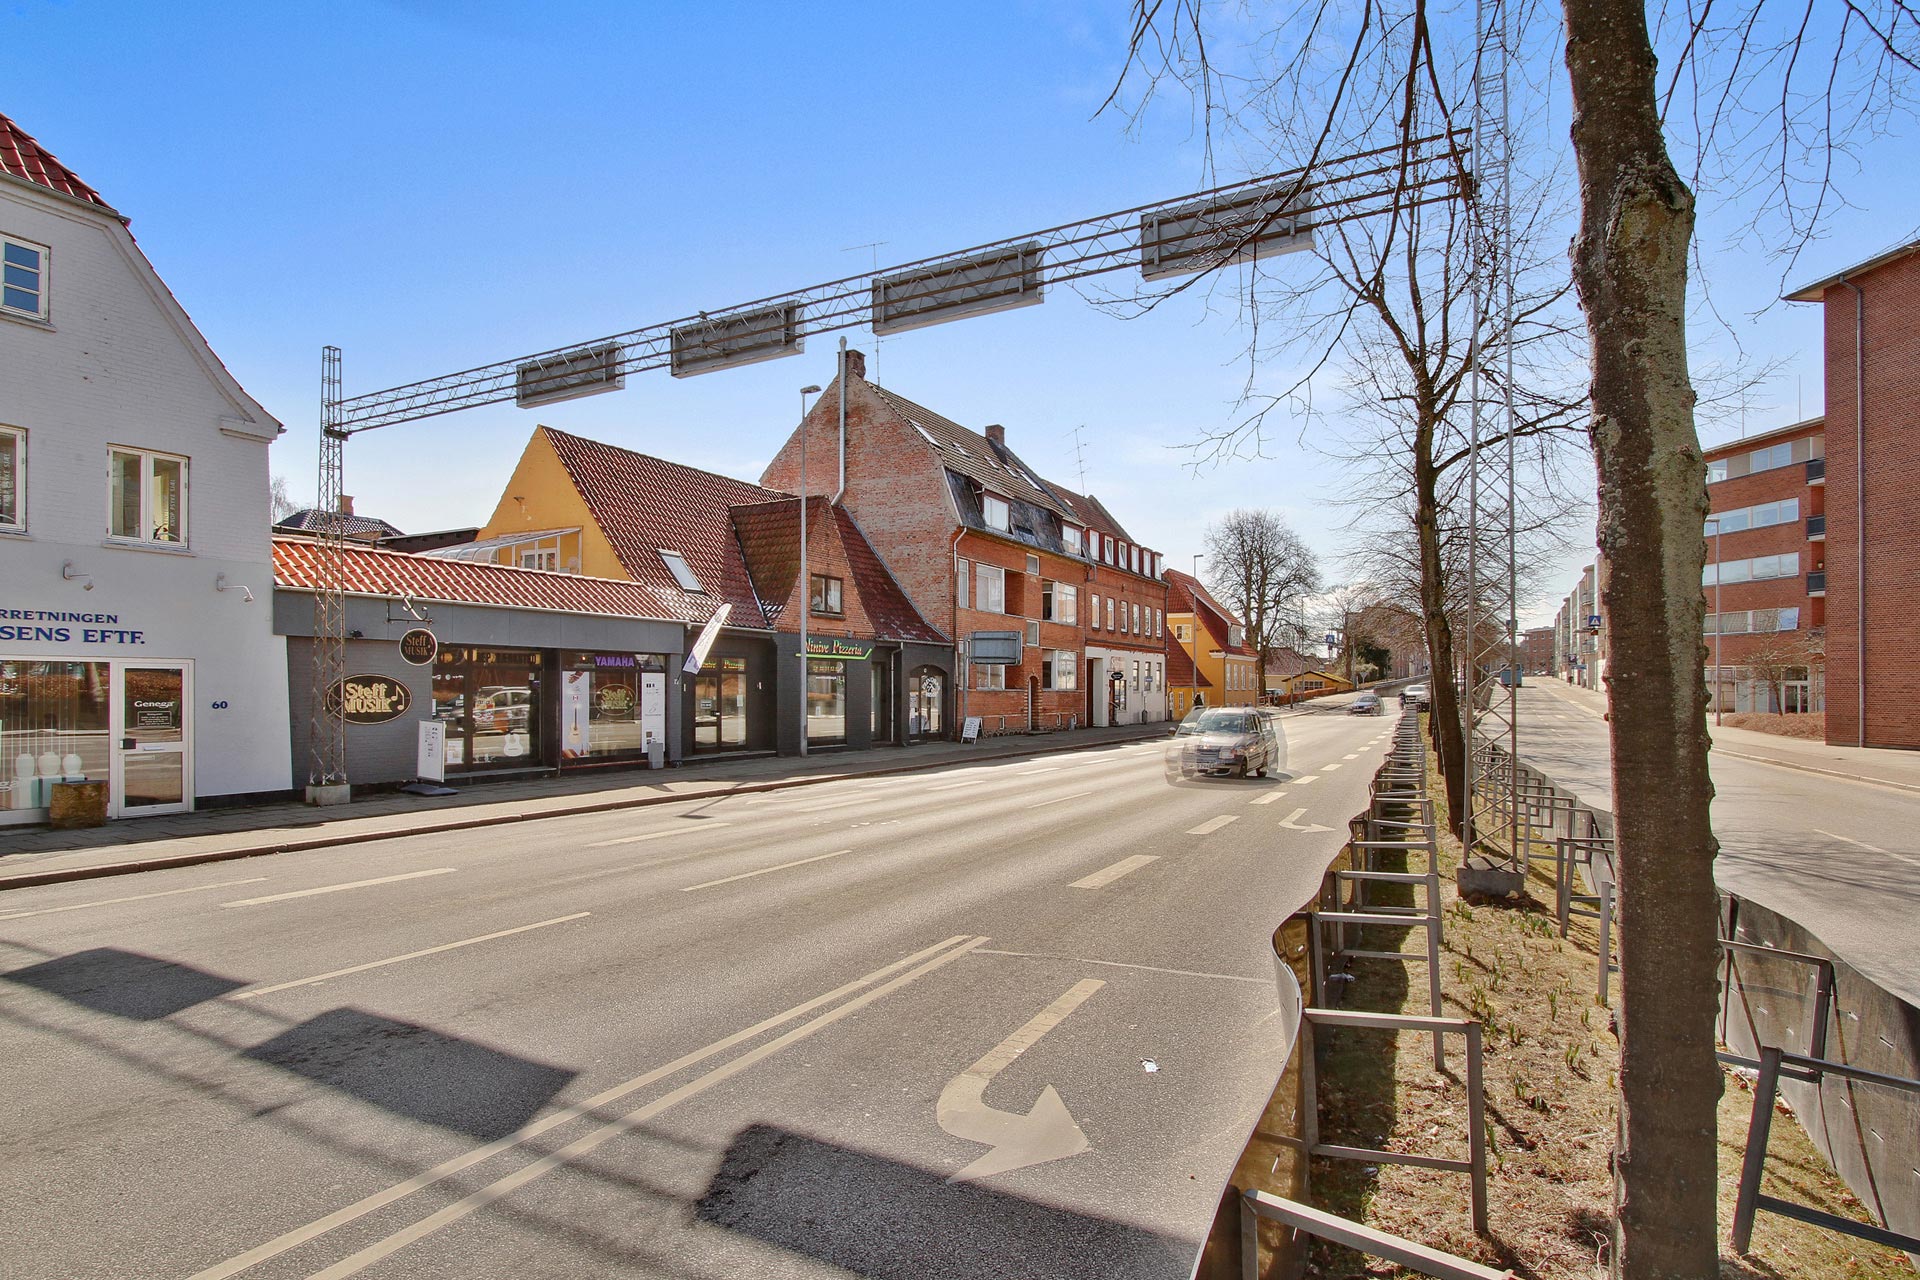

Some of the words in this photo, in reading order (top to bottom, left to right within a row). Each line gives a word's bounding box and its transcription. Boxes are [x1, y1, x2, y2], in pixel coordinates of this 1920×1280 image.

[0, 626, 70, 642] SENS
[83, 628, 145, 645] EFTF.
[405, 634, 427, 647] Steff
[404, 646, 428, 656] MUSIK
[806, 637, 829, 654] Ninive
[832, 639, 862, 656] Pizzeria
[595, 656, 635, 667] YAMAHA
[346, 682, 388, 699] Steff
[134, 700, 175, 709] Genega
[212, 701, 228, 709] 60
[344, 697, 393, 713] MUSIK
